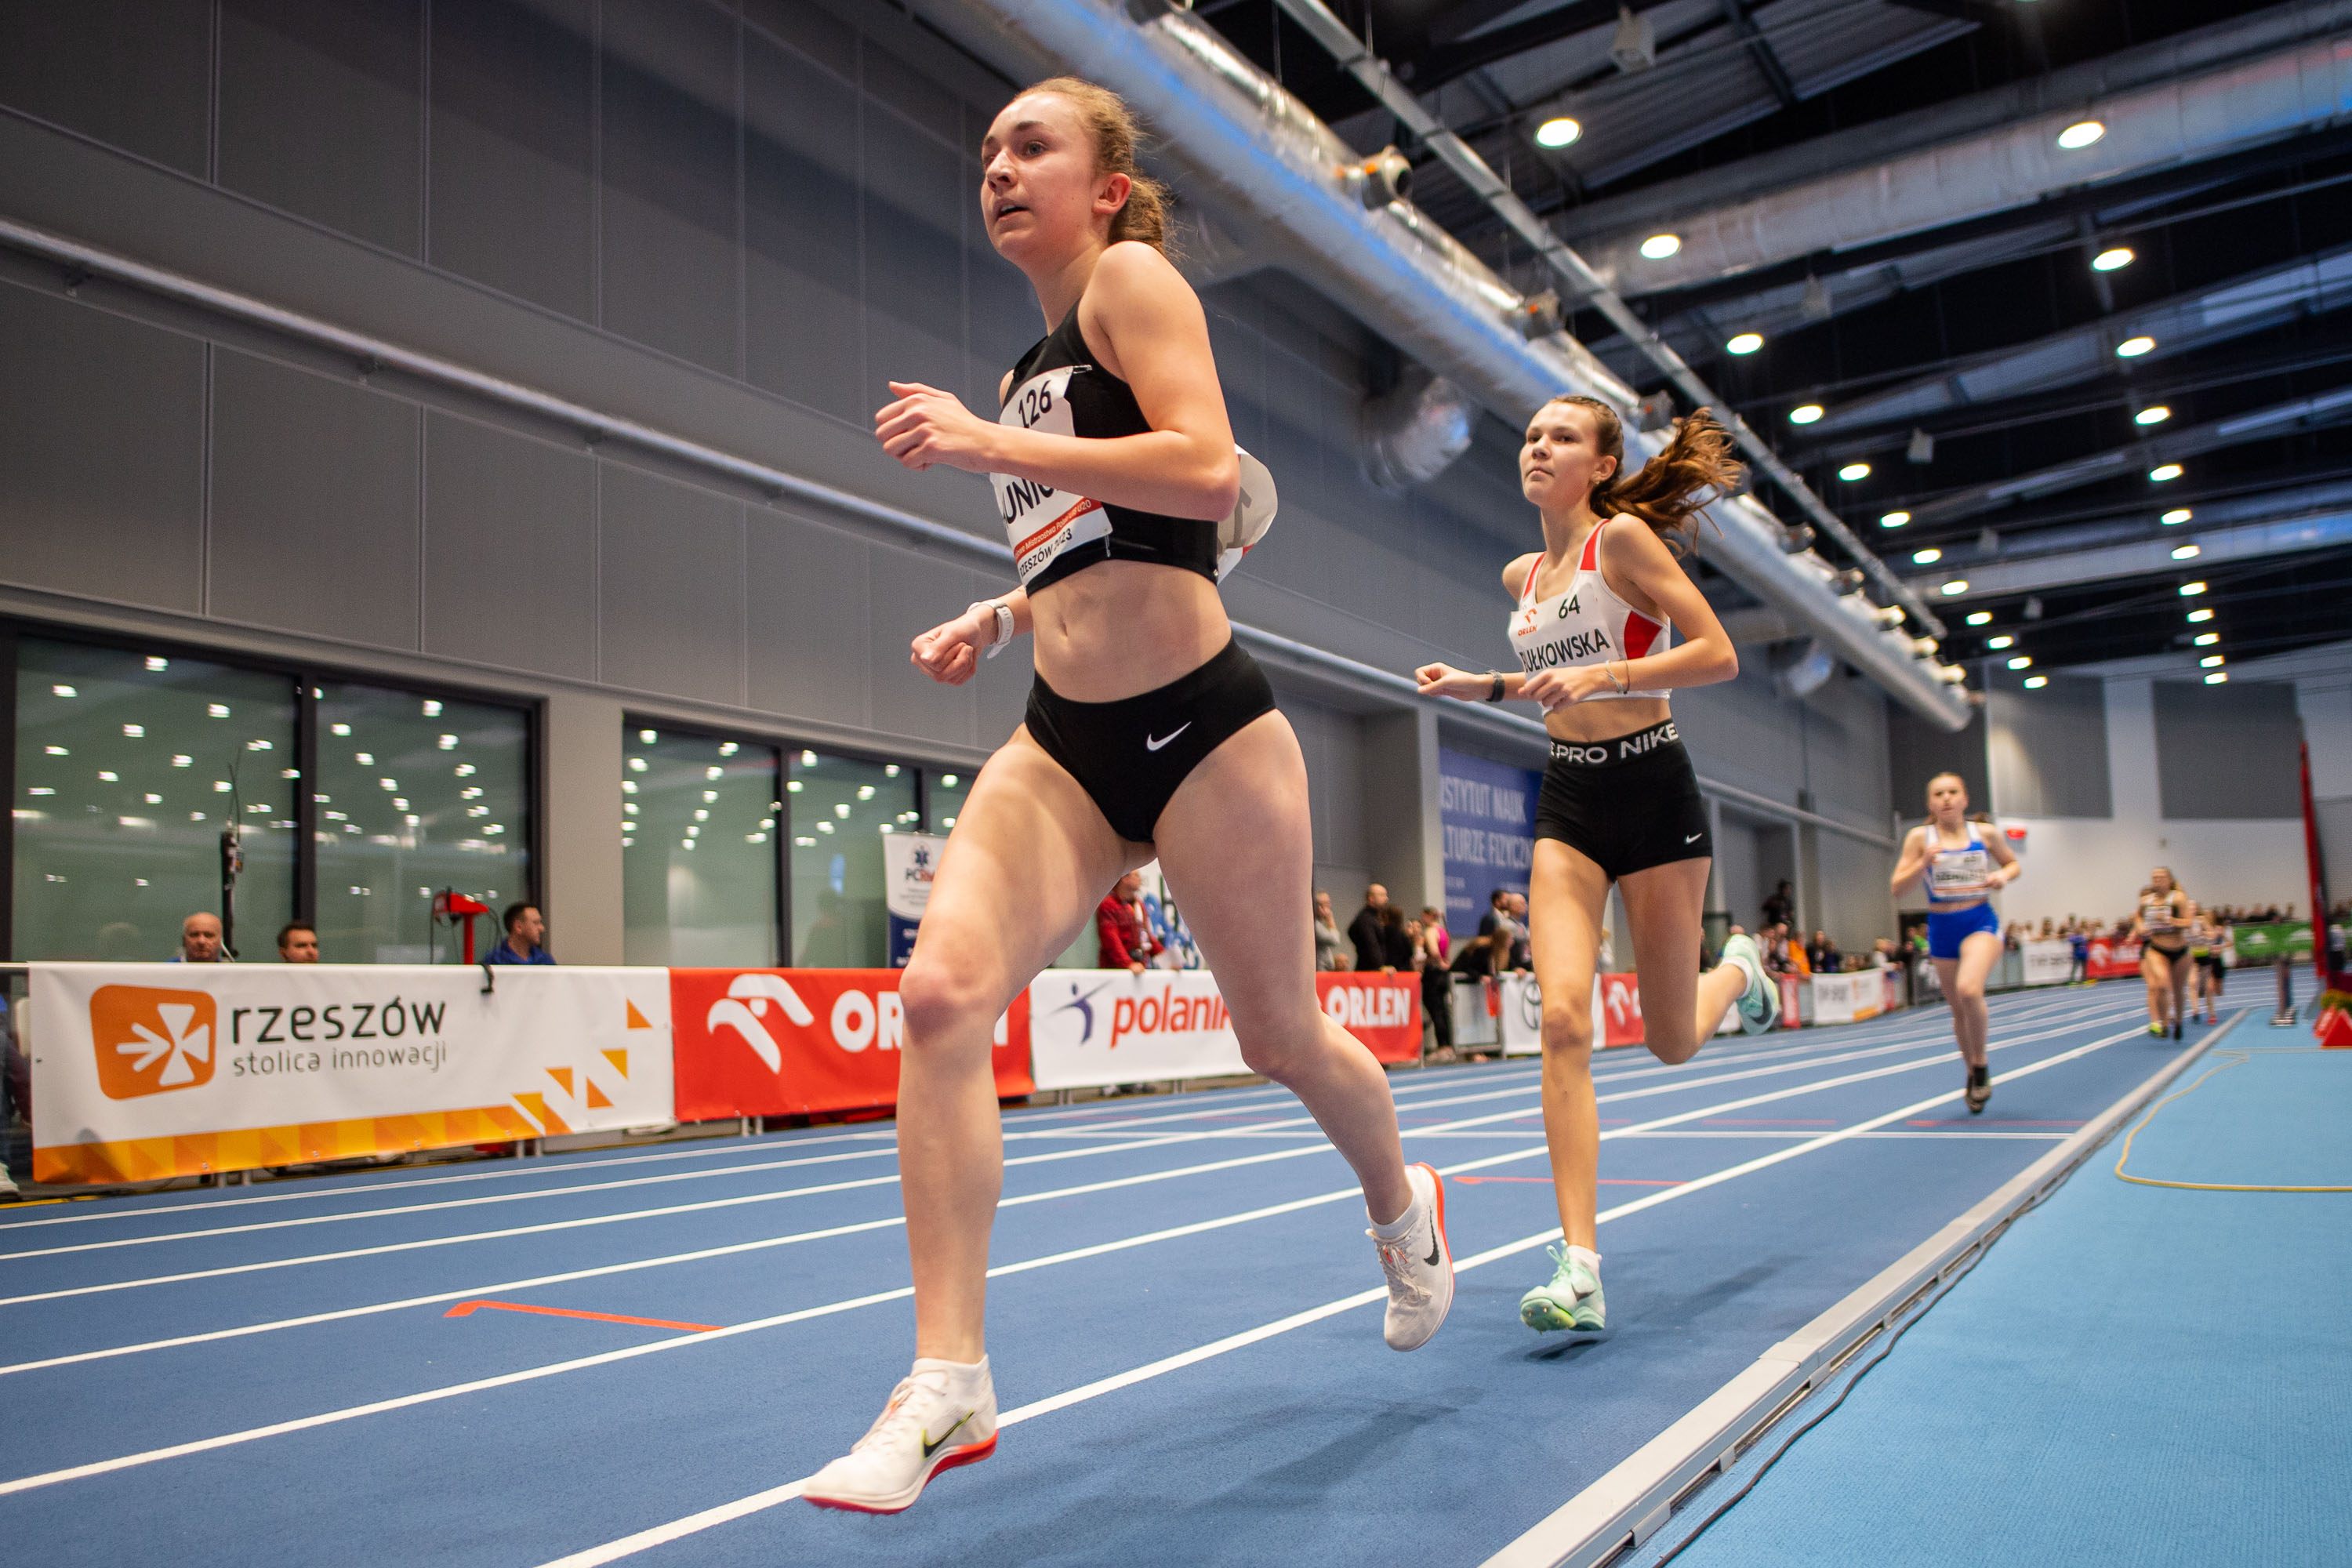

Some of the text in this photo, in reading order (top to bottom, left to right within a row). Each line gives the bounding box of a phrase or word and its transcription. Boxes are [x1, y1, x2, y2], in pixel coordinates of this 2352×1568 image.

[1018, 379, 1052, 429] 126
[1077, 499, 1092, 513] U20
[1559, 593, 1581, 619] 64
[1517, 625, 1537, 637] ORLEN
[1556, 744, 1608, 764] PRO
[1620, 722, 1679, 759] NIKE
[233, 995, 446, 1044] rzeszów
[1327, 985, 1411, 1028] ORLEN
[233, 1041, 447, 1077] stolica innowacji
